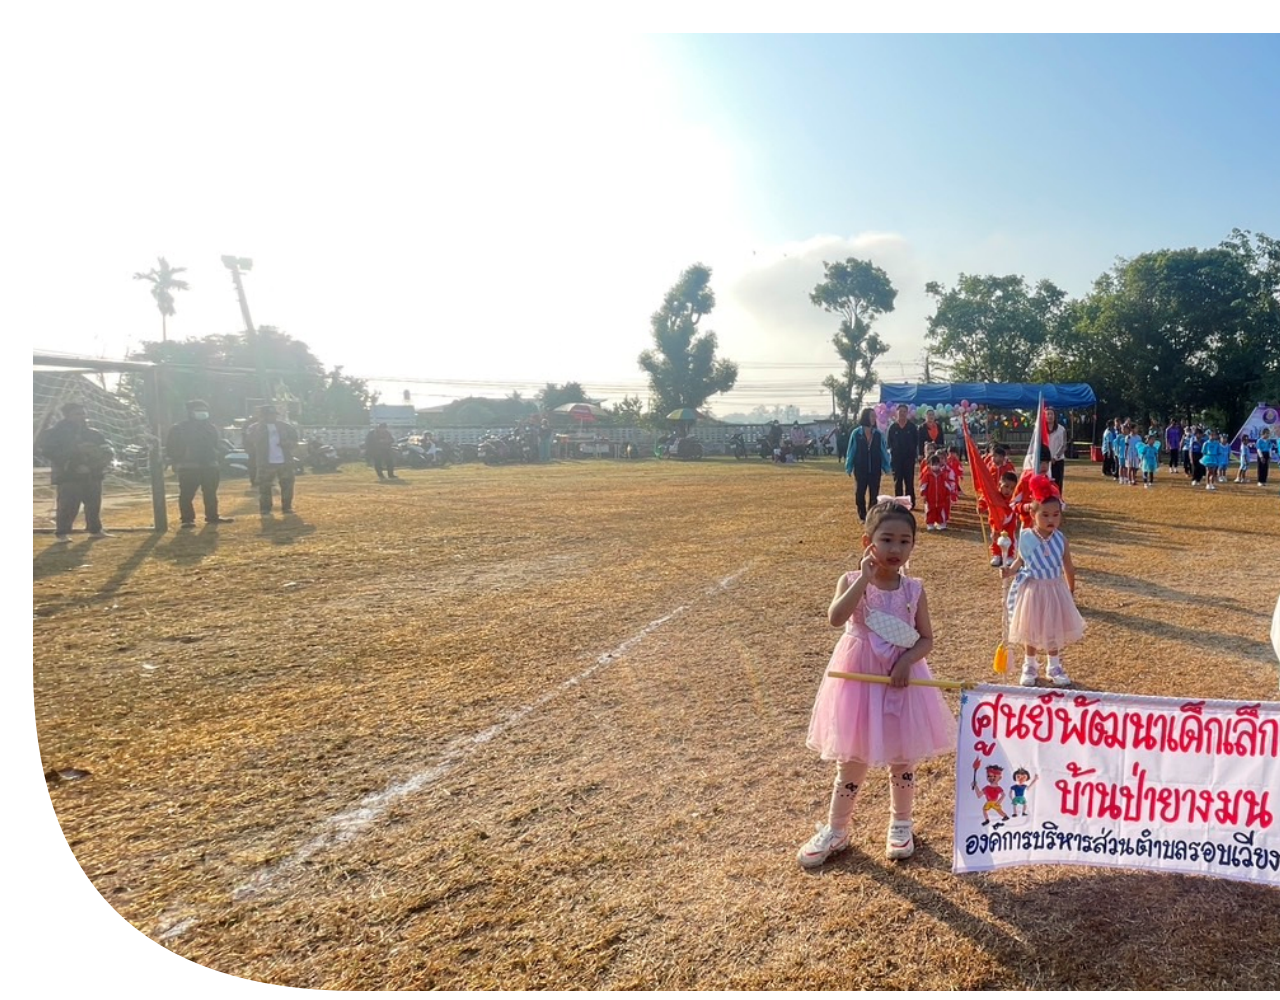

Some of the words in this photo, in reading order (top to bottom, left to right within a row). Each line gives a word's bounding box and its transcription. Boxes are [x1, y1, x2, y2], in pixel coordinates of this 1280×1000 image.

[971, 691, 1279, 757] ศูนย์พัฒนาเด็กเล็ก
[1054, 760, 1274, 829] บ้านป่ายางมน
